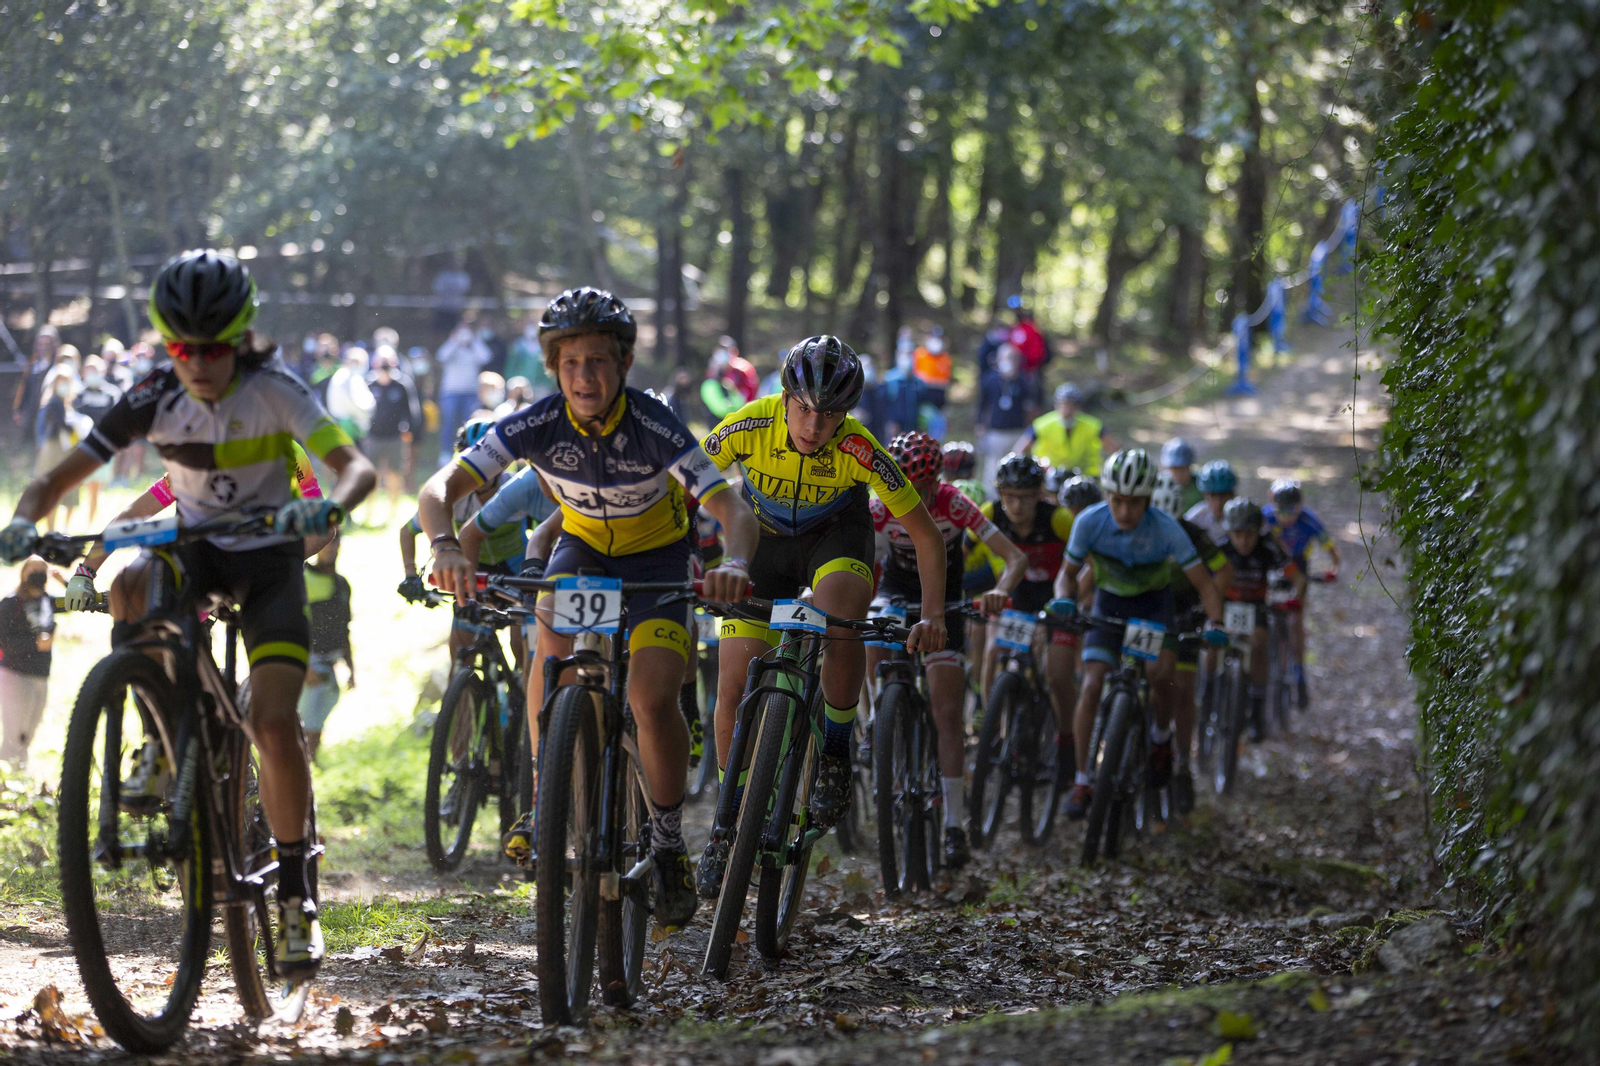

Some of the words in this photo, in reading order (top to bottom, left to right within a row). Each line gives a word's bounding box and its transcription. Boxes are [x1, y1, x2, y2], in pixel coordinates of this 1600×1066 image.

[504, 420, 526, 437] Club
[720, 417, 774, 440] Sumipor
[872, 460, 898, 491] CRESPO
[569, 593, 606, 626] 39
[791, 606, 807, 622] 4
